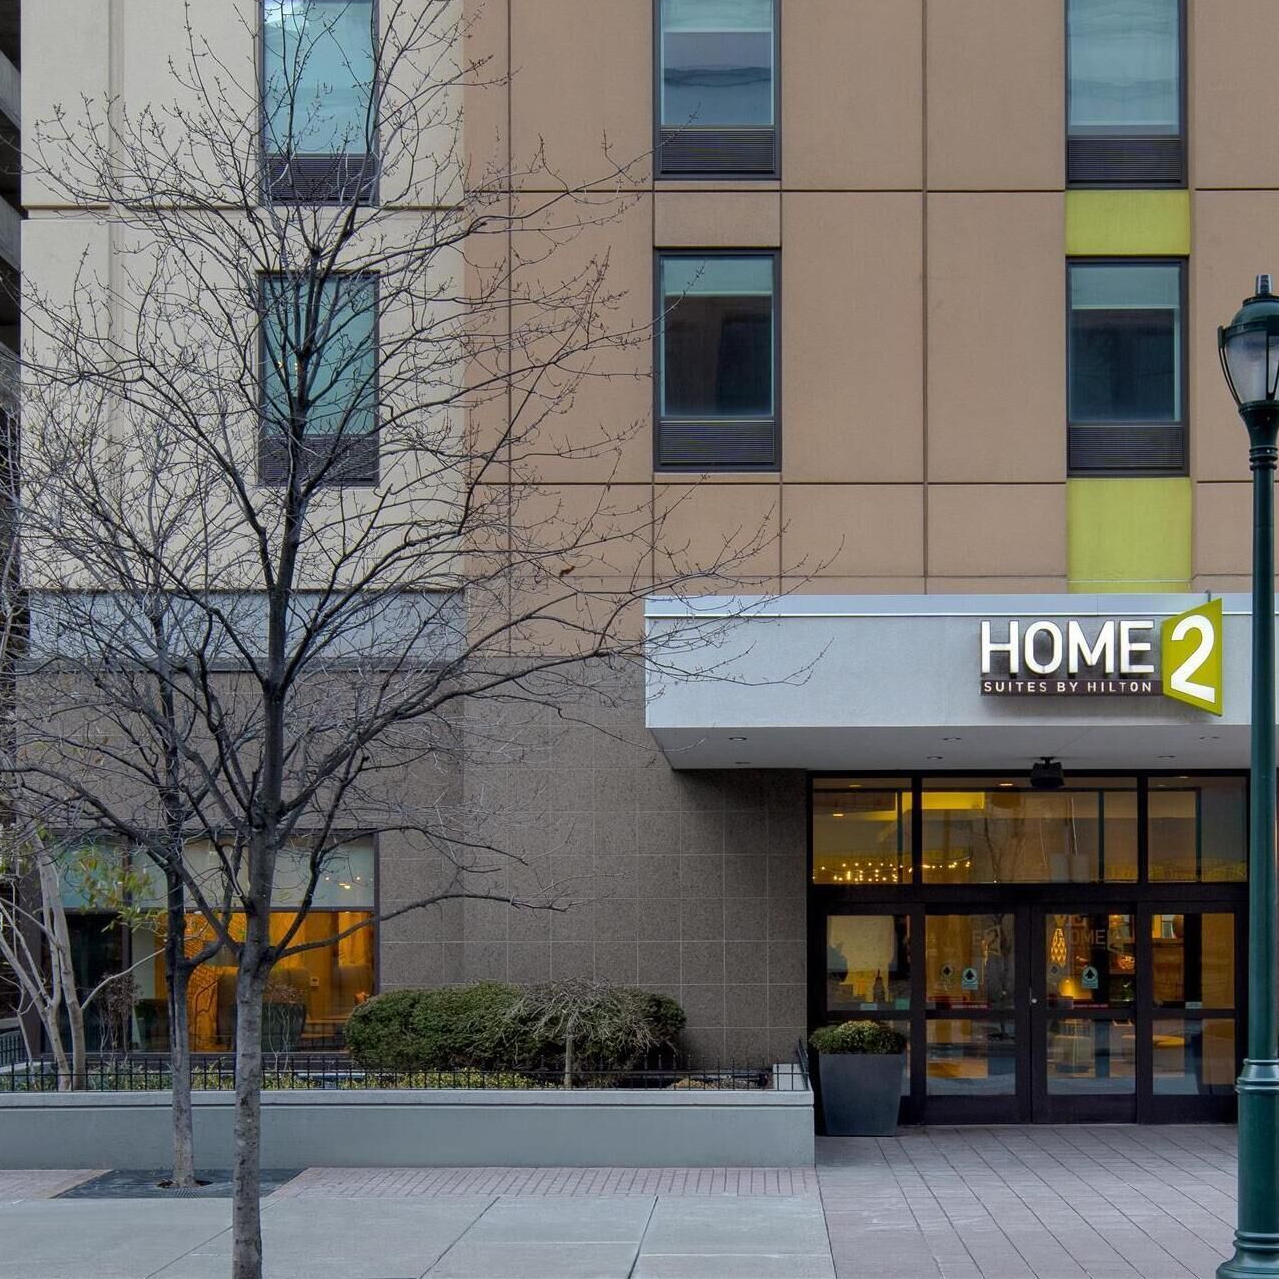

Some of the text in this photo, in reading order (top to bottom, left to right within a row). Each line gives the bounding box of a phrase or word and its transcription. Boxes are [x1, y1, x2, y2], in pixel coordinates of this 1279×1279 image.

[981, 614, 1216, 703] HOME 2
[983, 681, 1152, 693] SUITES BY HILTON
